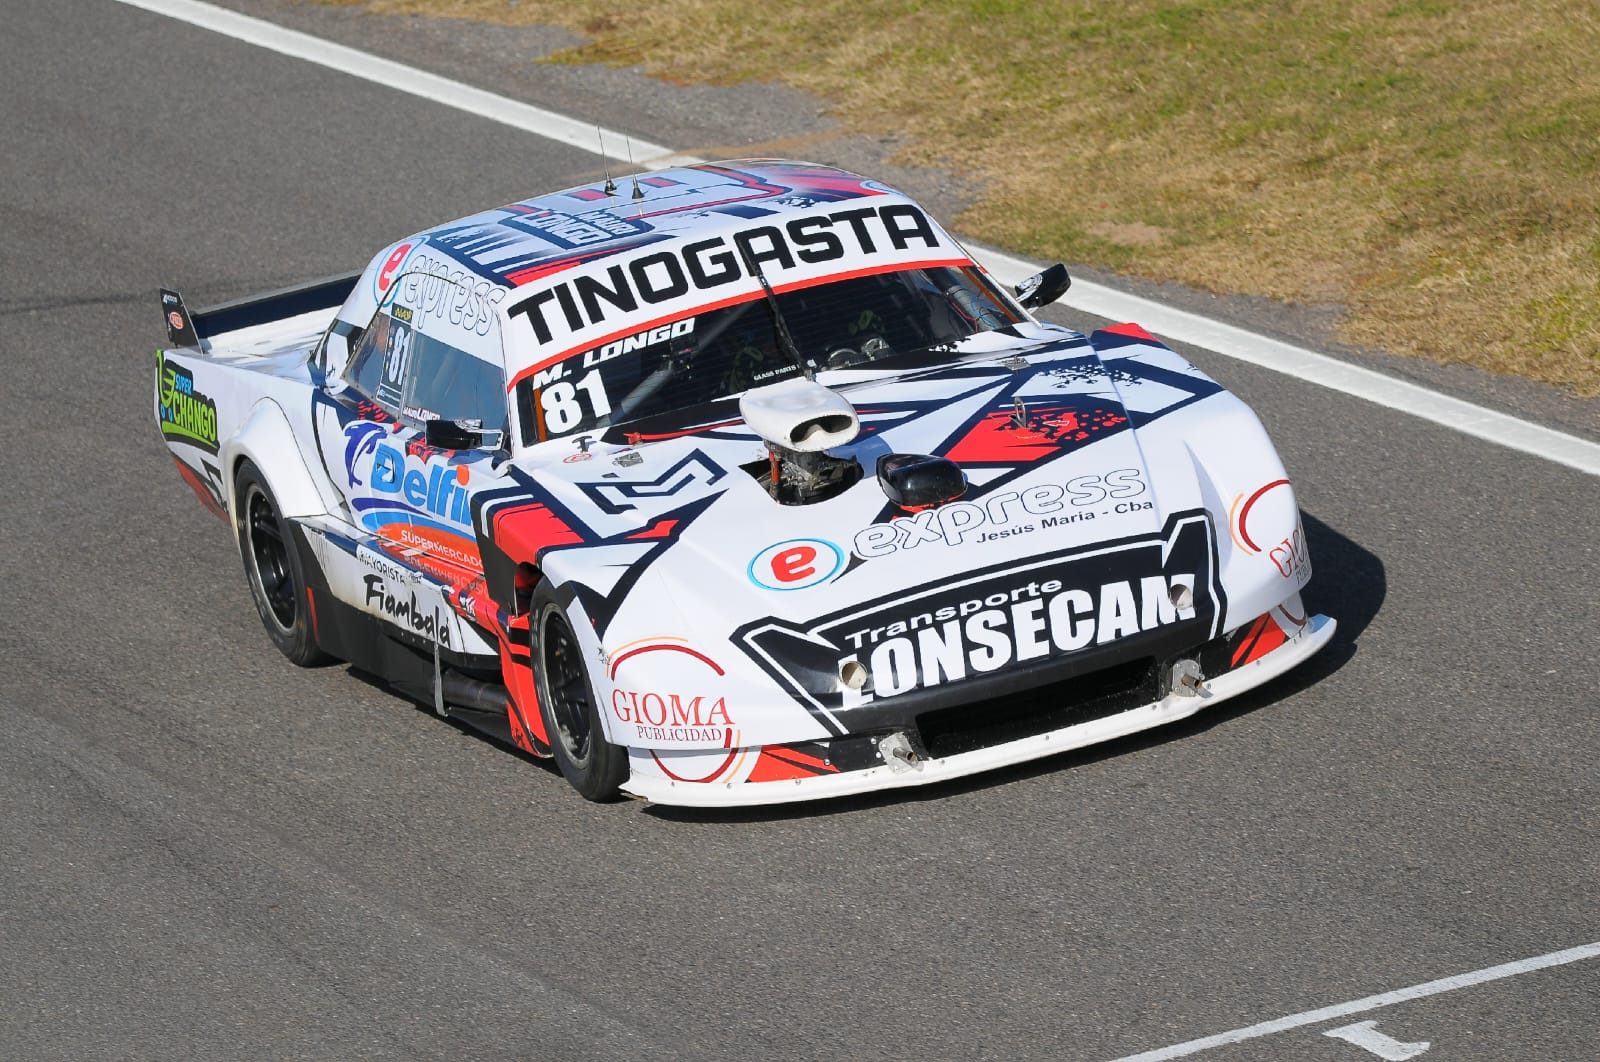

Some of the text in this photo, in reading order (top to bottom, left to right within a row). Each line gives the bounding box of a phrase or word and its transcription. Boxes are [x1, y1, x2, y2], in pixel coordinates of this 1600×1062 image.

[404, 254, 506, 336] express
[507, 203, 941, 346] TINOGASTA
[388, 326, 411, 386] 81
[532, 317, 696, 391] M. LONGO
[753, 370, 774, 381] GLASS
[774, 364, 797, 375] PARTS
[175, 373, 192, 396] SUPER
[539, 368, 612, 434] 81
[172, 391, 217, 442] CHANGO
[853, 468, 1147, 559] express
[976, 523, 1035, 544] Jesús
[1041, 510, 1096, 530] María
[1113, 499, 1154, 515] Cba
[845, 579, 1063, 650] Transporte
[612, 688, 736, 727] GIOMA
[636, 725, 722, 742] PUBLICIDAD
